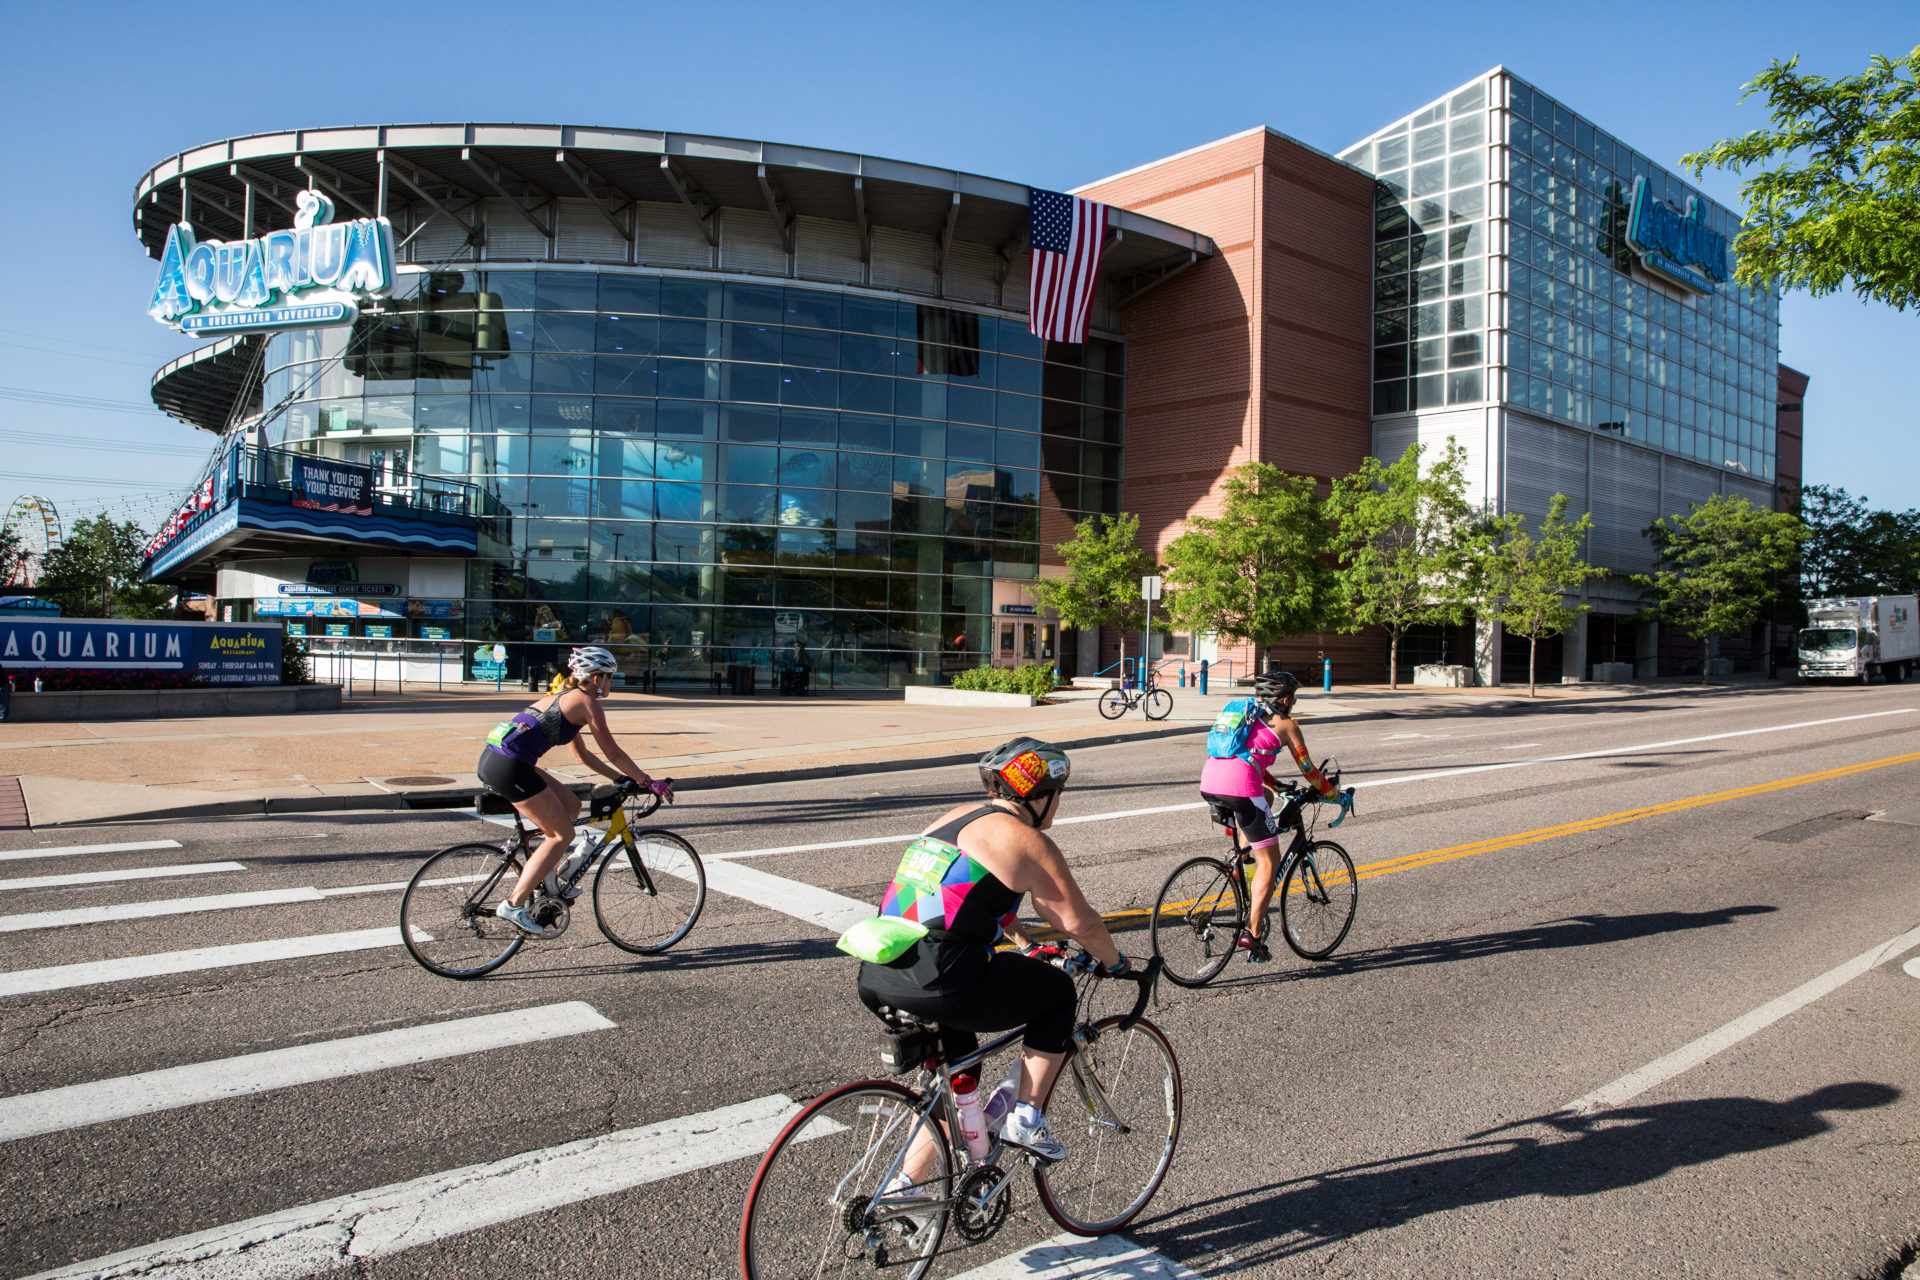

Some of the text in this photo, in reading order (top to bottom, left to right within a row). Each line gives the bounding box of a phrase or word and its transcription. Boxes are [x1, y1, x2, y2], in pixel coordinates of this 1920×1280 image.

[149, 218, 386, 319] AQUARIUM
[190, 306, 336, 328] AN UNDERWATER ADVENTURE
[303, 466, 364, 488] THANK YOU FOR
[305, 480, 361, 500] YOUR SERVICE
[4, 629, 181, 660] AQUARIUM
[209, 632, 266, 649] AQUARIUM
[908, 849, 938, 873] 590
